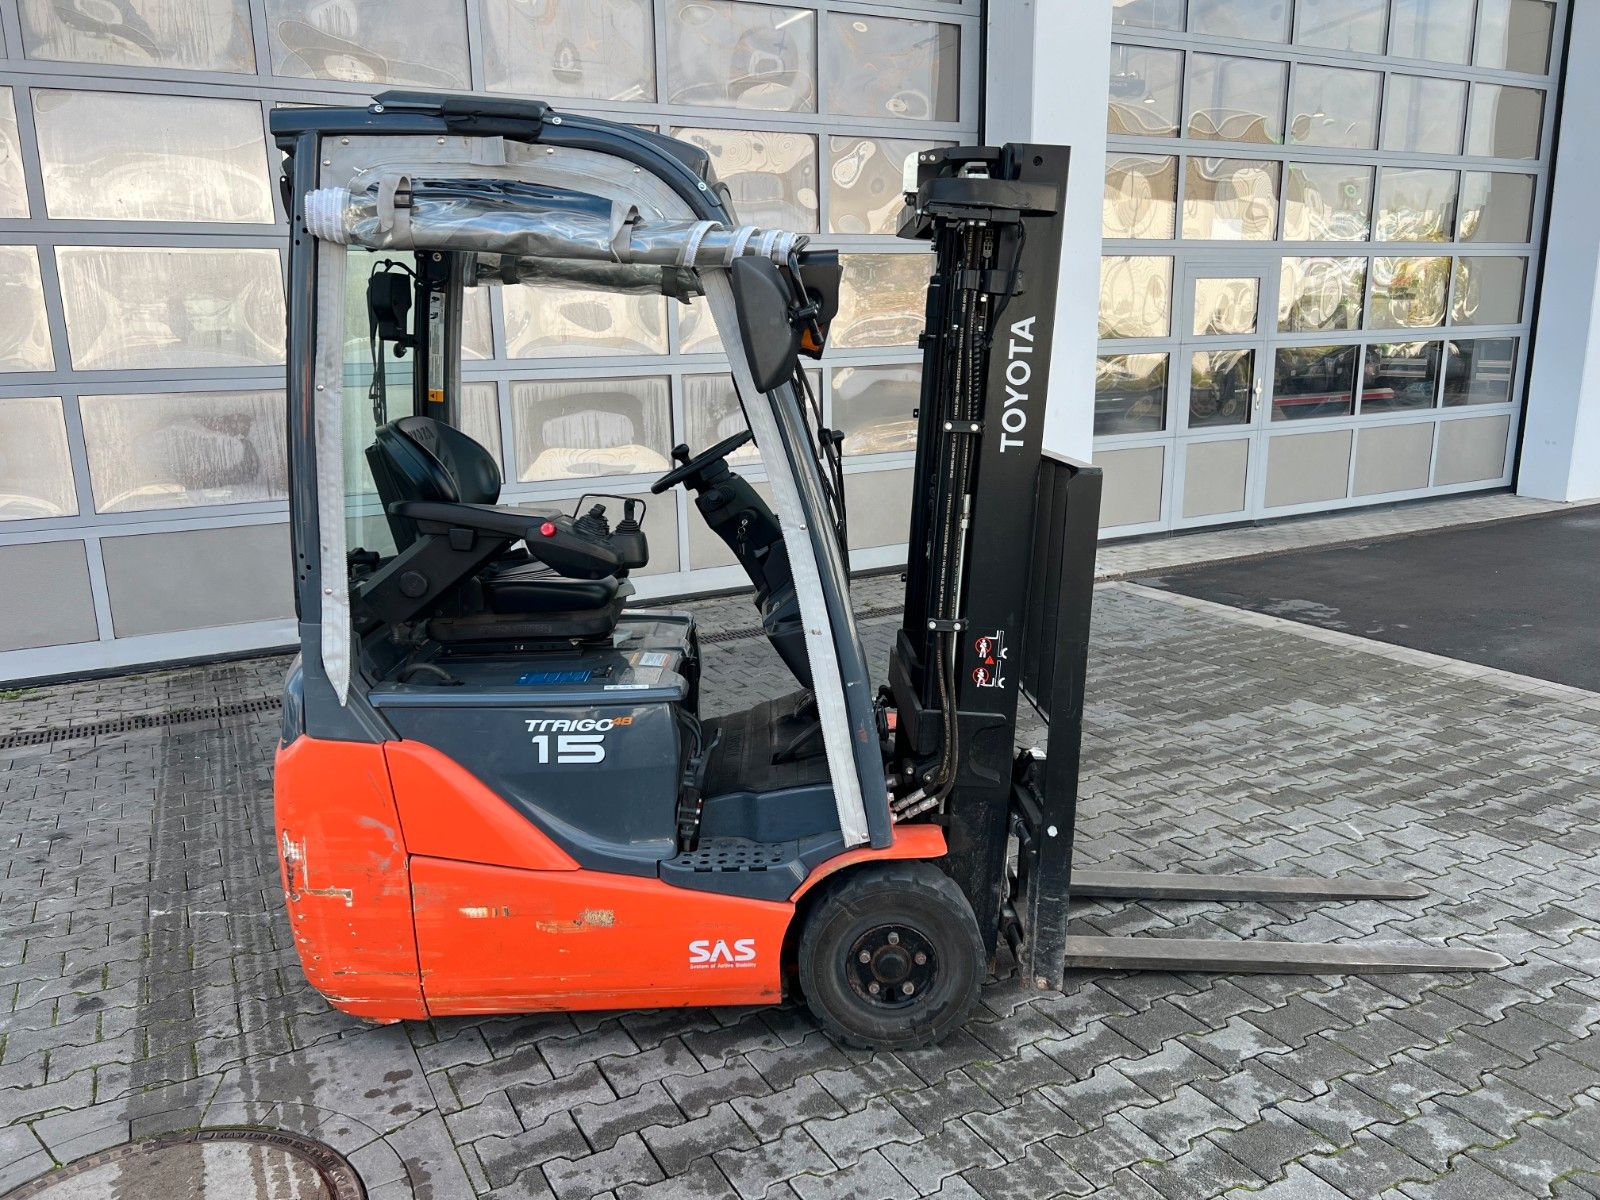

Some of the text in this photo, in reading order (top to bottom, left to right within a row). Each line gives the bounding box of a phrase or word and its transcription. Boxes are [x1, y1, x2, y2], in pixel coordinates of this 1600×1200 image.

[999, 315, 1037, 452] TOYOTA
[525, 716, 633, 732] TRAIGO 48
[531, 734, 606, 764] 15
[688, 938, 757, 963] SAS
